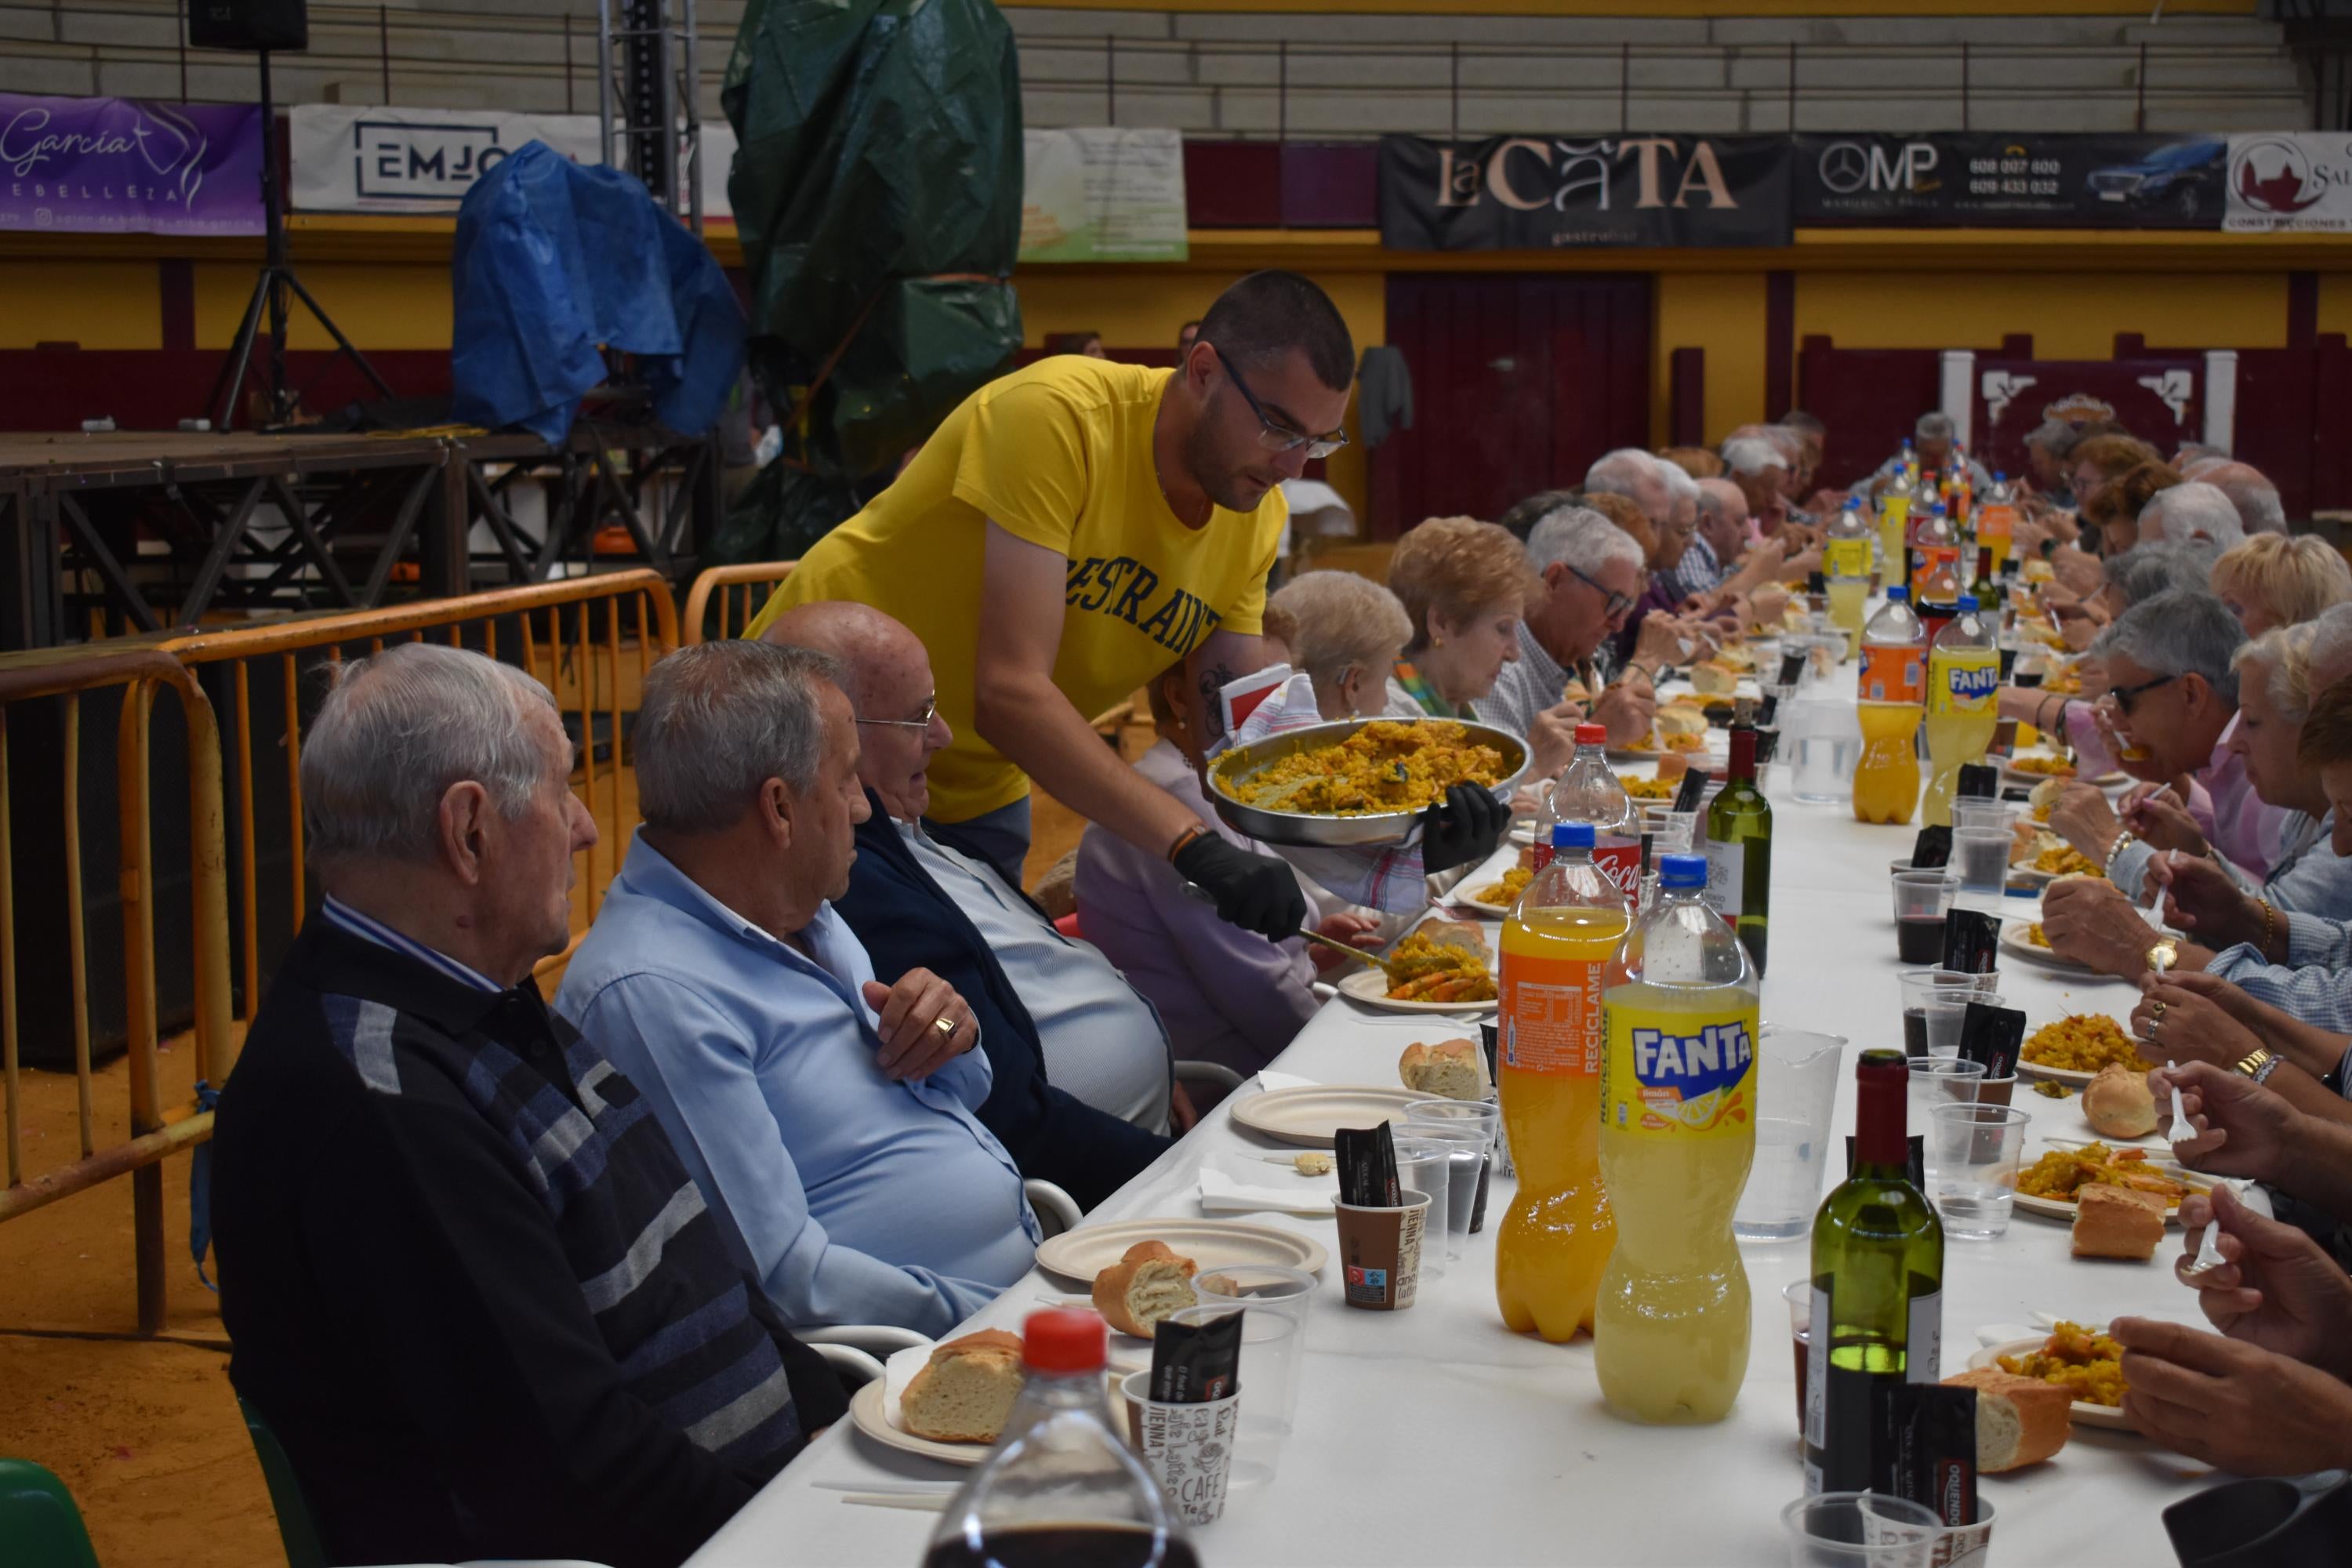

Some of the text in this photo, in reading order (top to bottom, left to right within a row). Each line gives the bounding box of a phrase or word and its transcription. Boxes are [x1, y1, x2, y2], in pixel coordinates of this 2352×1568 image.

[1870, 143, 1939, 191] MP
[1582, 963, 1601, 1073] RECÍCLAME
[1633, 1023, 1751, 1078] FANTA
[1948, 1464, 1961, 1526] OQUENDO
